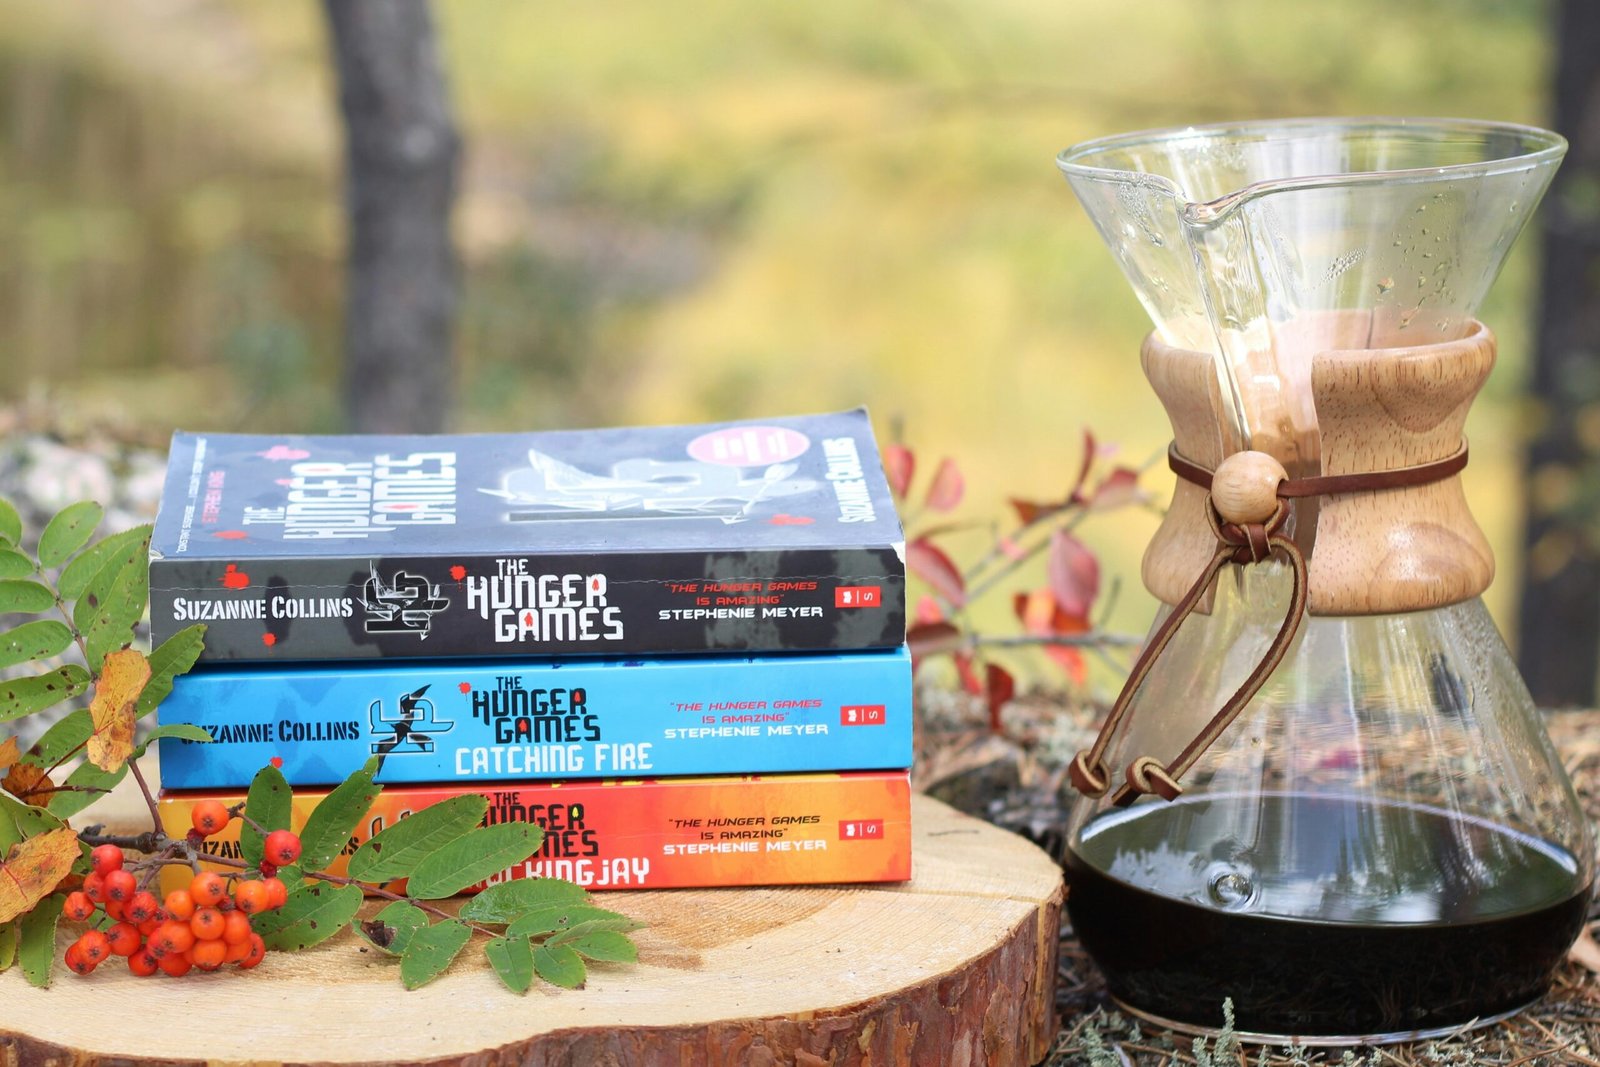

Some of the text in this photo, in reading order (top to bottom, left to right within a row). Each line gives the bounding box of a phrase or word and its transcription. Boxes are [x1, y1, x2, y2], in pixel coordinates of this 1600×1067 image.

[371, 452, 457, 525] GAMES
[283, 462, 396, 539] HUNGER
[242, 506, 285, 525] THE
[496, 559, 529, 581] THE
[467, 573, 608, 620] HUNGER
[664, 581, 818, 593] "THE HUNGER GAMES
[173, 595, 353, 622] SUZANNE COLLINS
[696, 594, 785, 606] IS AMAZING"
[658, 606, 824, 620] STEPHENIE MEYER
[495, 606, 624, 643] GAMES
[496, 676, 523, 694] THE
[472, 687, 587, 726] HUNGER
[670, 698, 822, 712] "THE HUNGER GAMES
[701, 712, 790, 724] IS AMAZING"
[181, 719, 360, 744] ZANNE COLLINS
[495, 715, 601, 744] GAMES
[664, 724, 829, 740] STEPHENIE MEYER
[455, 742, 653, 775] CATCHING FIRE
[493, 792, 521, 809] THE
[669, 815, 821, 828] "THE HUNGER GAMES
[700, 828, 788, 840] IS AMAZING"
[533, 829, 599, 859] MES
[663, 839, 827, 855] STEPHENIE MEYER
